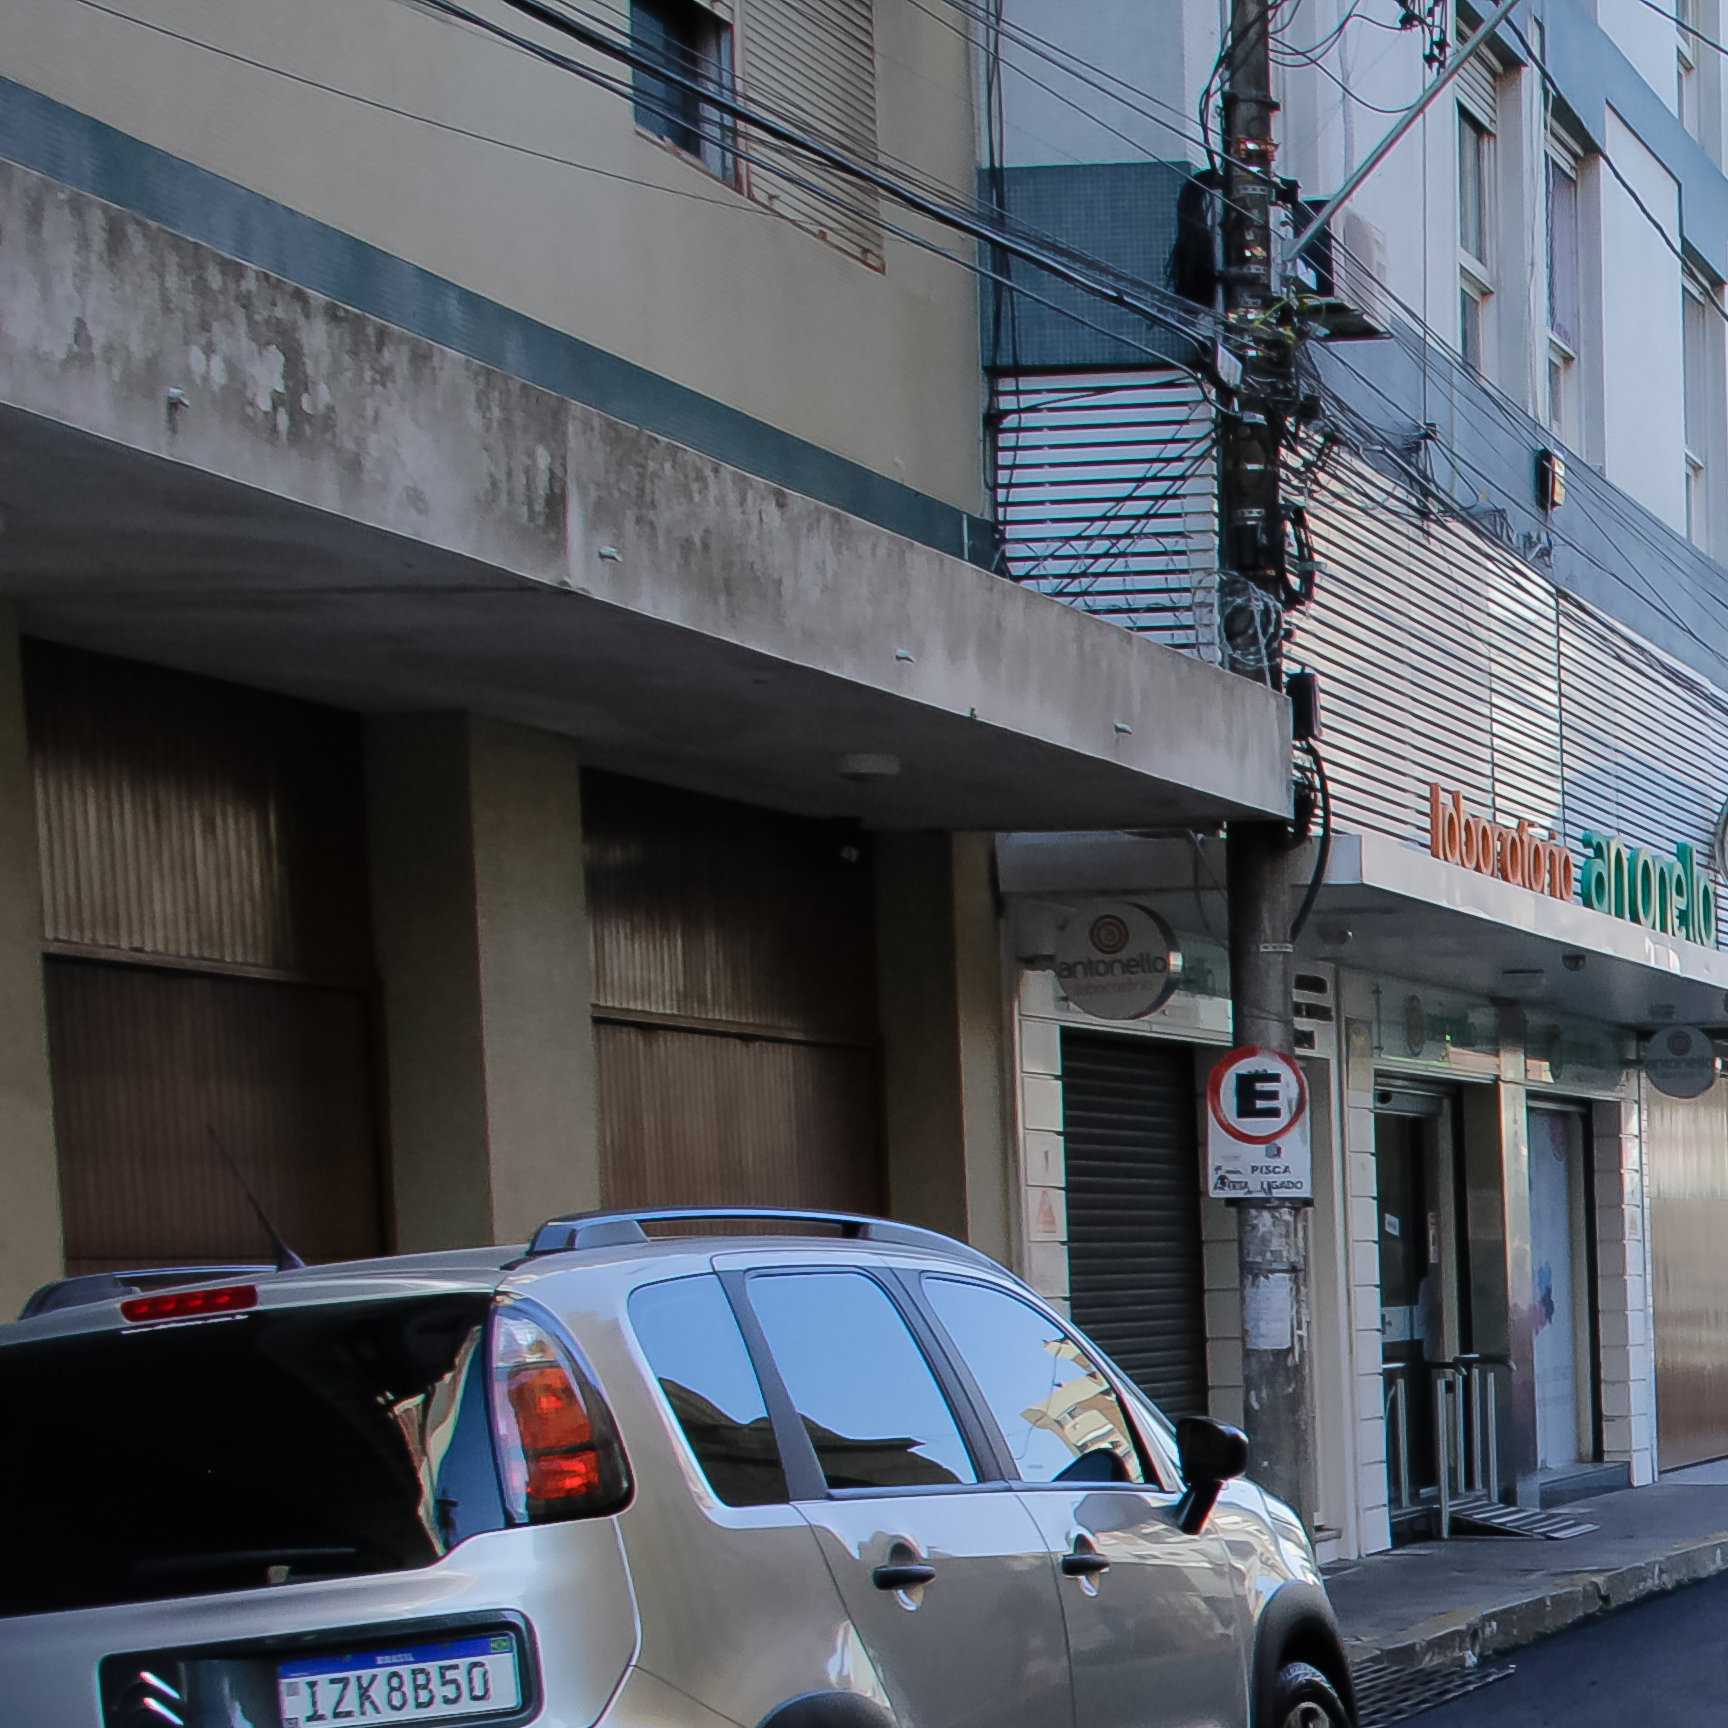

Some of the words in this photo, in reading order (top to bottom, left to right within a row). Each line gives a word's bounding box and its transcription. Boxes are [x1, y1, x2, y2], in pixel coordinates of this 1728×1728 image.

[1581, 829, 1718, 948] antonello
[1060, 953, 1167, 979] antonello
[1235, 1073, 1281, 1118] E
[1251, 1165, 1291, 1175] PISCA
